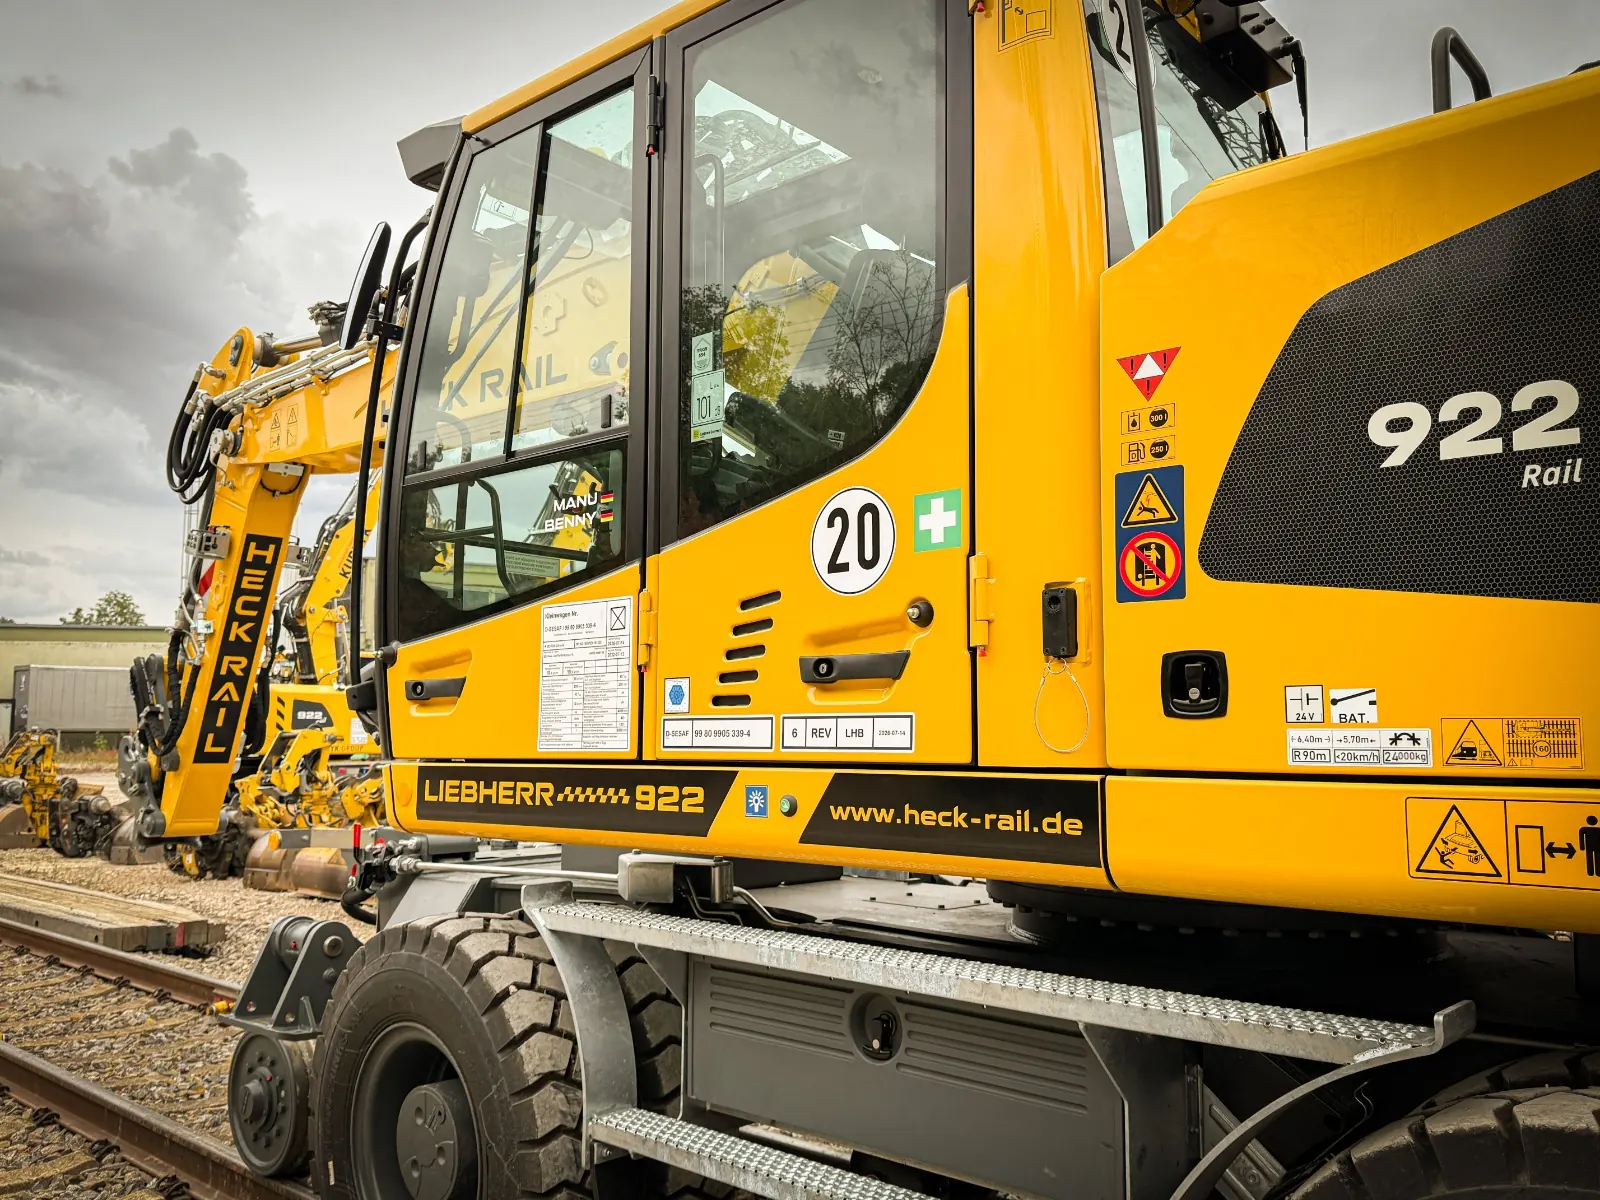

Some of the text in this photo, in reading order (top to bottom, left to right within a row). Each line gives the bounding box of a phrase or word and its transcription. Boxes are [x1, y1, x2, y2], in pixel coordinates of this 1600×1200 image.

[479, 353, 568, 403] RAIL
[696, 395, 711, 420] 101
[1150, 414, 1163, 422] 300
[1367, 379, 1581, 468] 922
[1150, 445, 1164, 453] 250
[1521, 458, 1583, 489] Rail
[553, 492, 598, 511] MANU
[544, 511, 597, 532] BENNY
[827, 502, 880, 574] 20
[203, 542, 276, 753] HECK RAIL
[297, 711, 323, 720] 922
[1339, 713, 1370, 723] BAT.
[694, 729, 703, 738] 99
[703, 729, 713, 738] 80
[713, 729, 731, 738] 9905
[731, 729, 751, 738] 339-4
[791, 728, 798, 738] 6
[811, 728, 832, 738] REV
[845, 728, 864, 738] LHB
[1294, 751, 1301, 760] R
[1303, 751, 1327, 761] 90m
[1336, 752, 1379, 762] <20km/h
[1533, 745, 1549, 753] 160
[424, 779, 704, 813] LIEBHERR 922
[829, 803, 1084, 836] www.heck-rail.de
